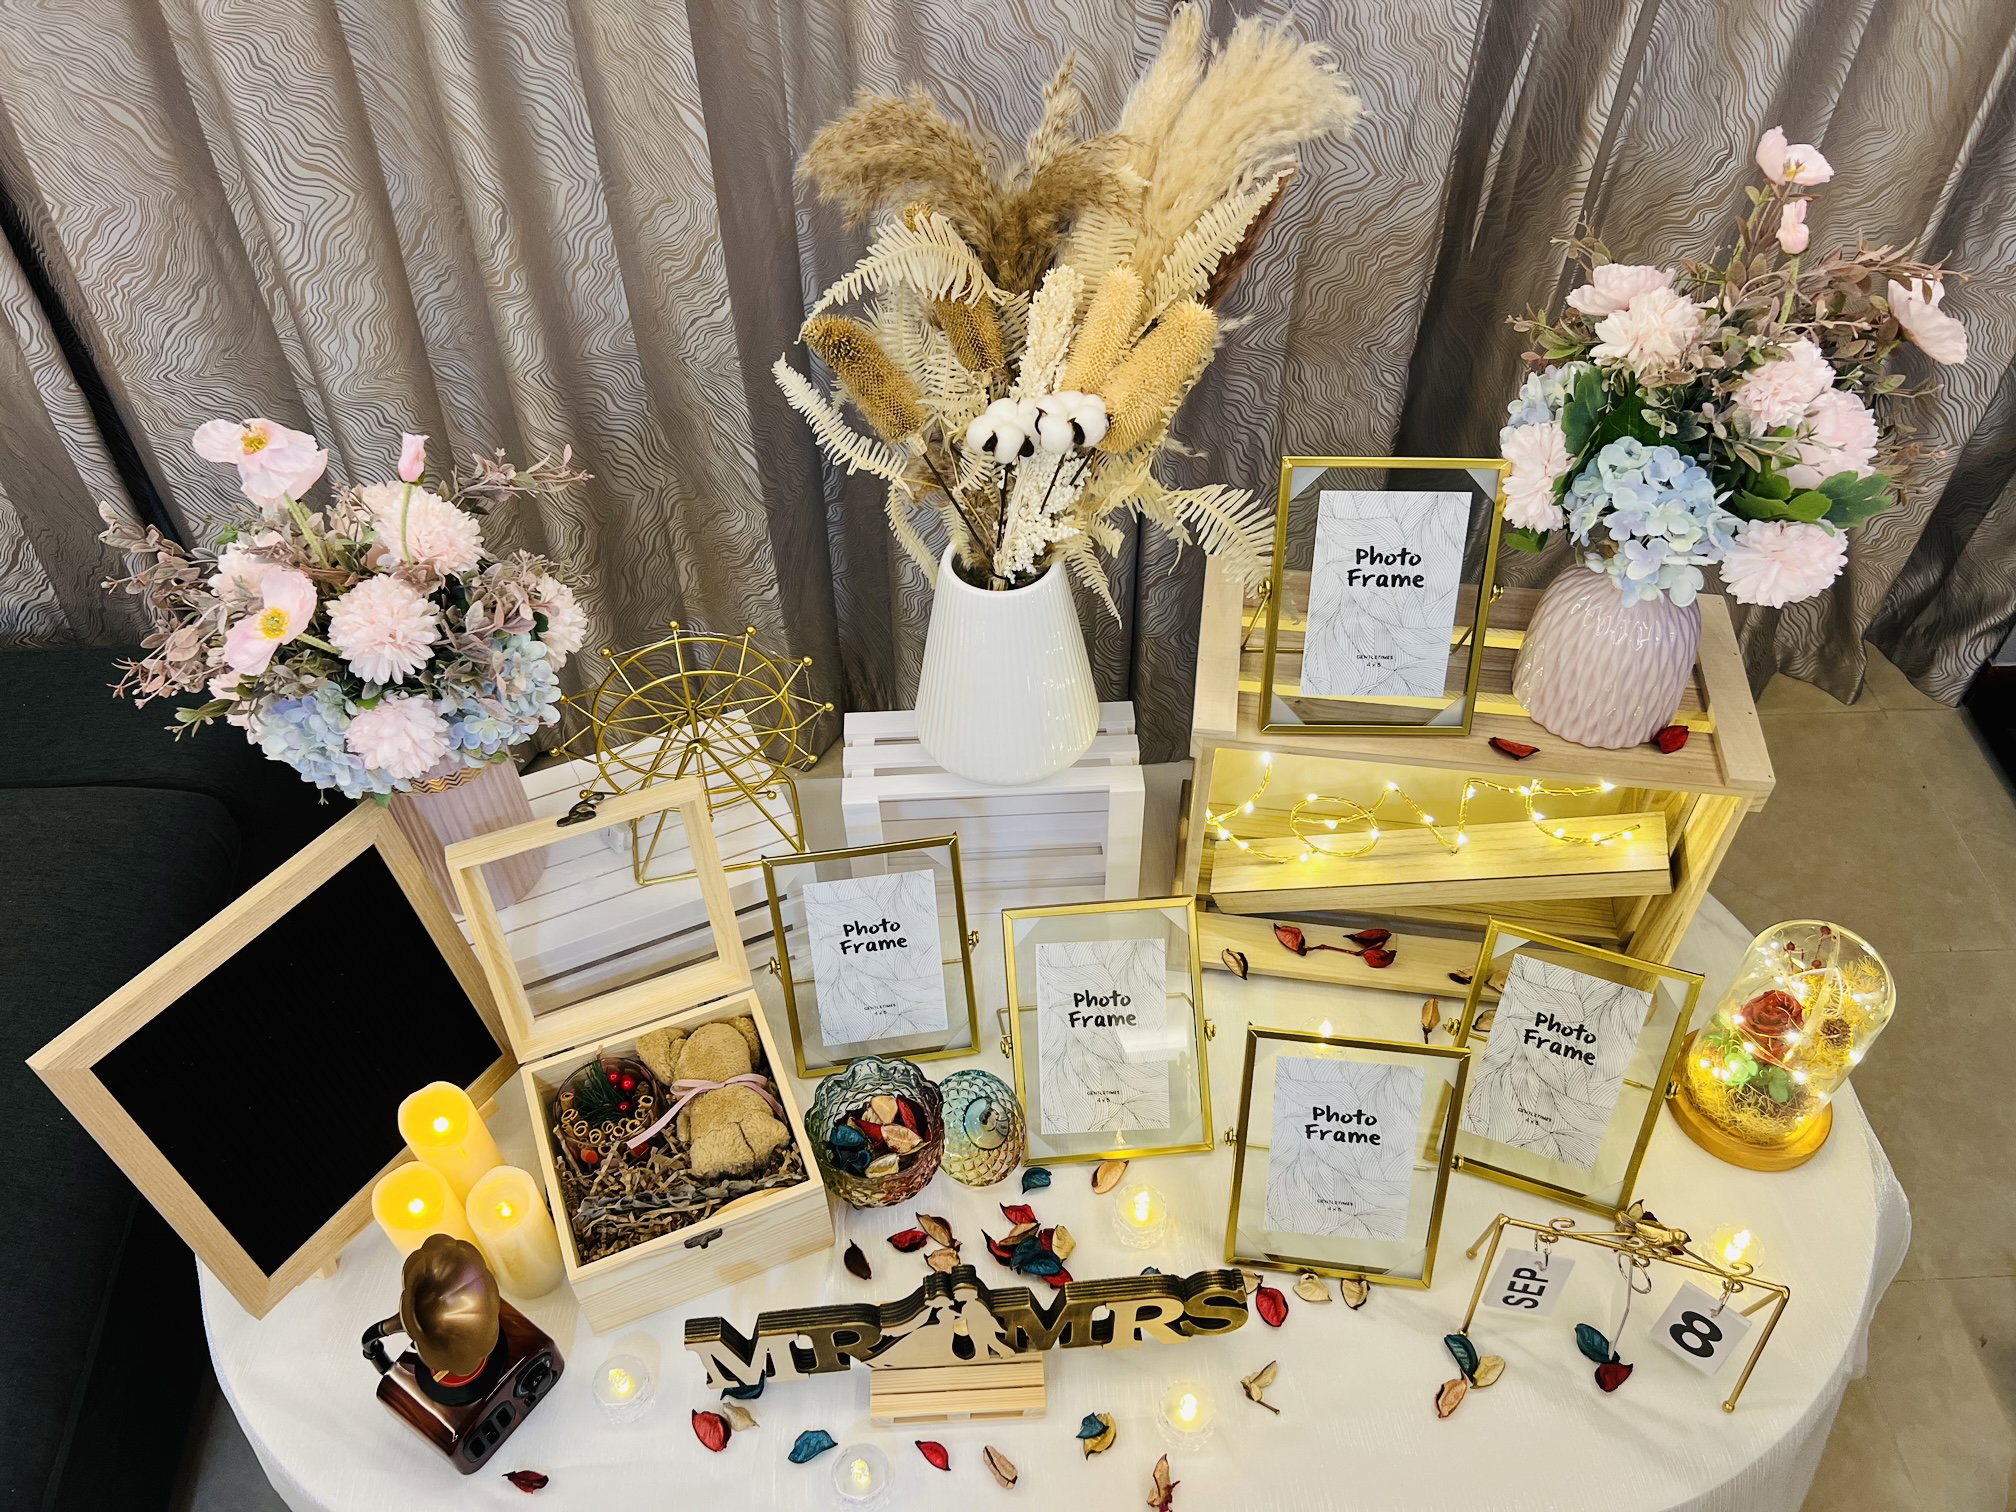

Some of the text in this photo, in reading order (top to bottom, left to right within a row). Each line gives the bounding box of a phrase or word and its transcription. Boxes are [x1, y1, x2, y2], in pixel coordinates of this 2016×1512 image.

[1355, 546, 1422, 567] Photo
[1346, 568, 1425, 588] Frame
[843, 918, 901, 937] Photo
[839, 937, 908, 955] Frame
[1073, 990, 1132, 1008] Photo
[1068, 1011, 1137, 1028] Frame
[1535, 1011, 1597, 1044] Photo
[1523, 1028, 1596, 1066] Frame
[1312, 1104, 1378, 1126] Photo
[1304, 1123, 1381, 1146] Frame
[1502, 1267, 1549, 1309] SEP
[1669, 1310, 1723, 1358] 8
